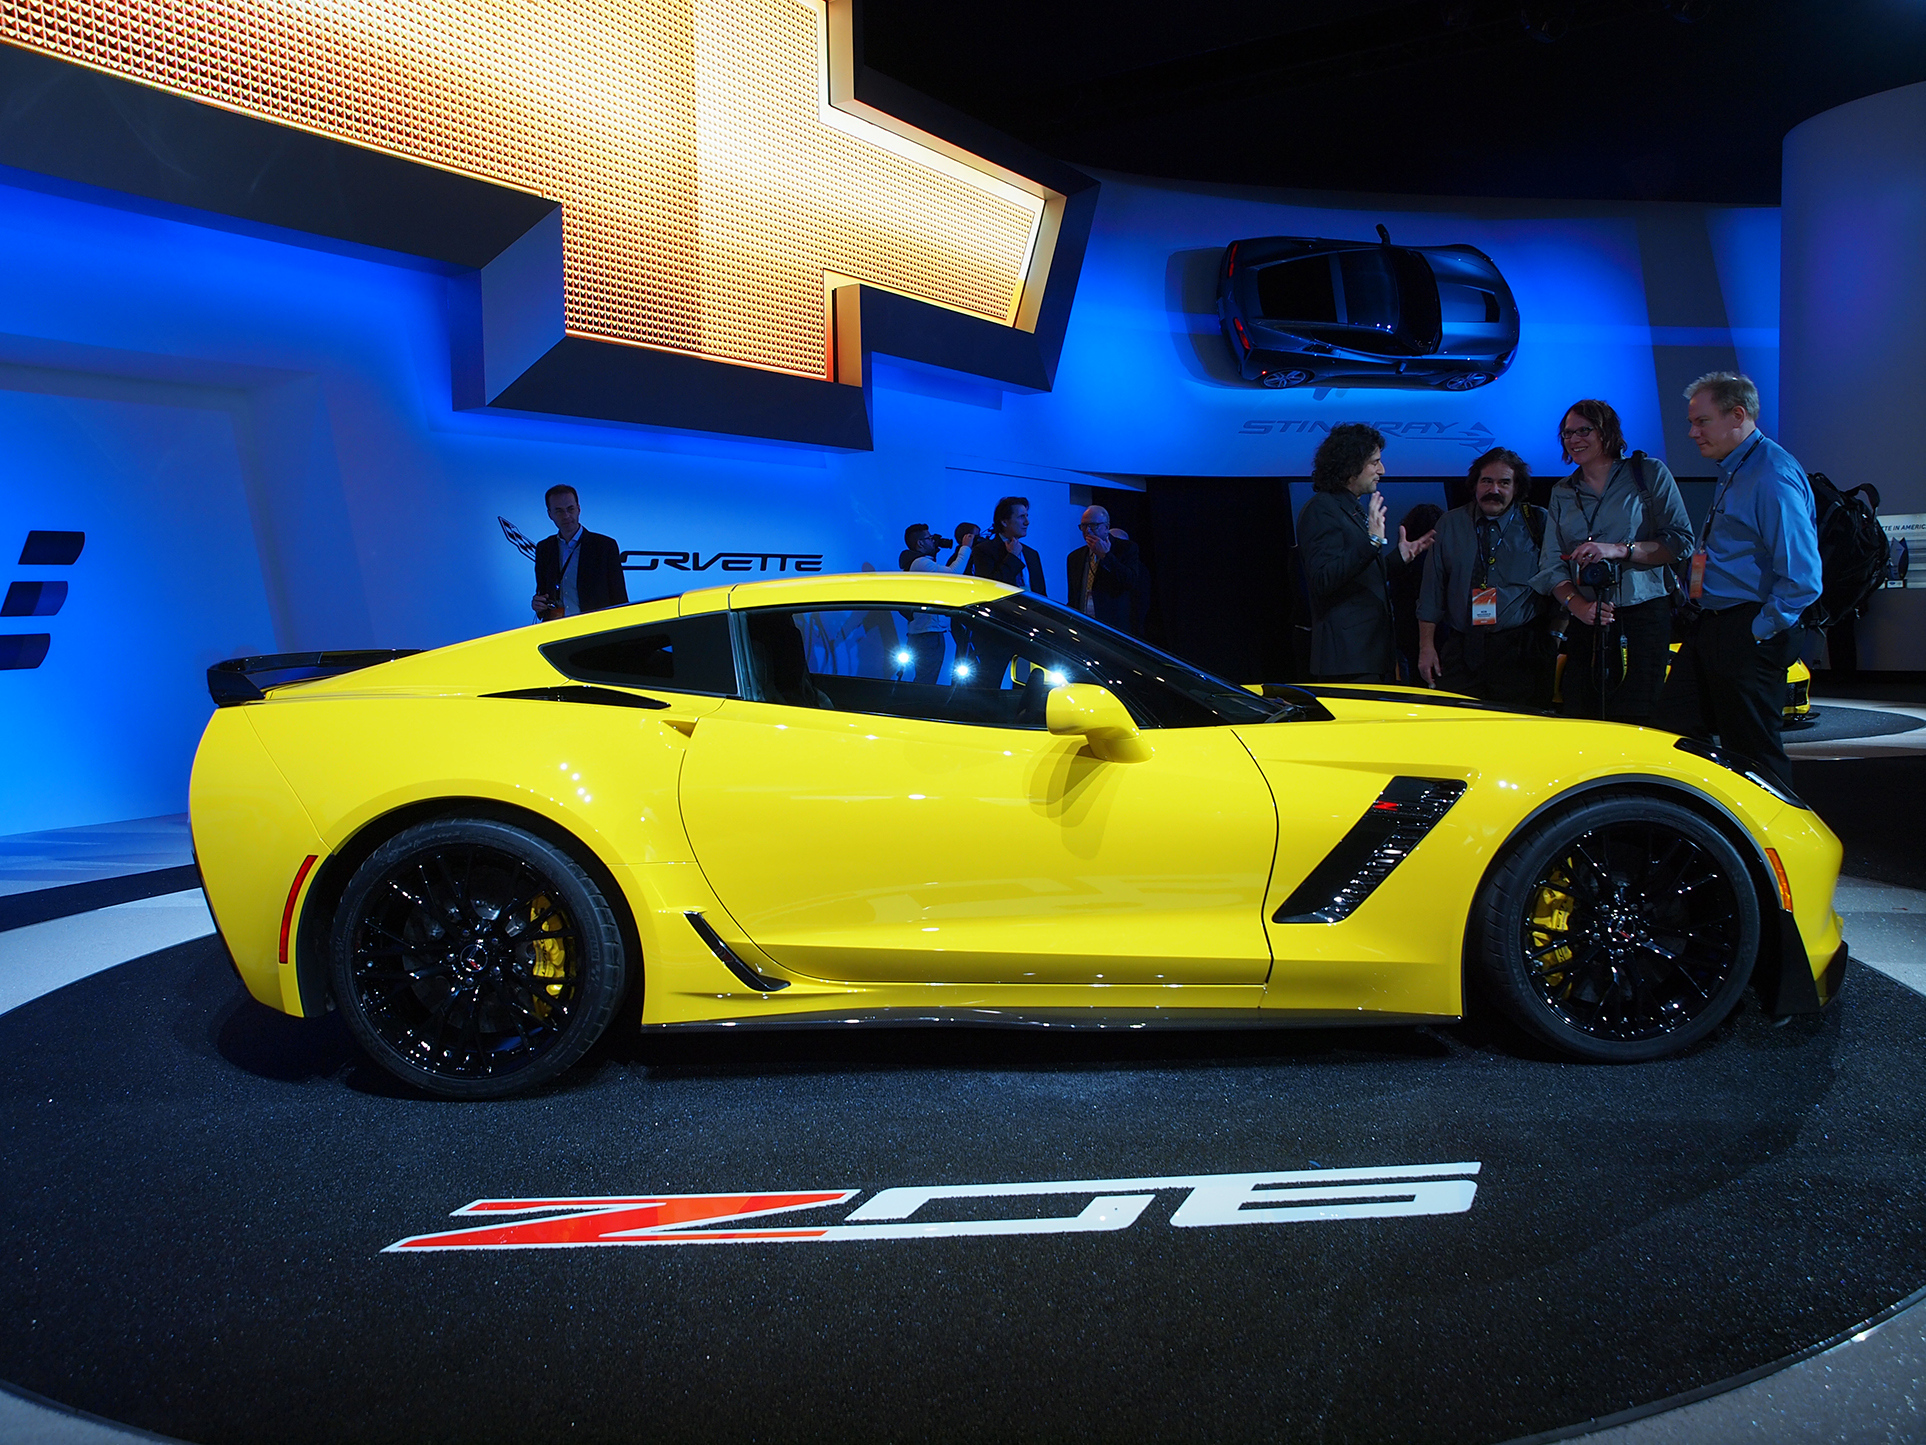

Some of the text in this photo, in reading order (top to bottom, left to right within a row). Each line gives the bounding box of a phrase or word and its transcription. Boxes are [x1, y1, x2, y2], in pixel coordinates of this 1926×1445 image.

[1238, 420, 1458, 438] STINRAY
[1901, 523, 1926, 531] AMERIC
[619, 550, 824, 572] ORVETTE
[380, 1161, 1482, 1253] Z06
